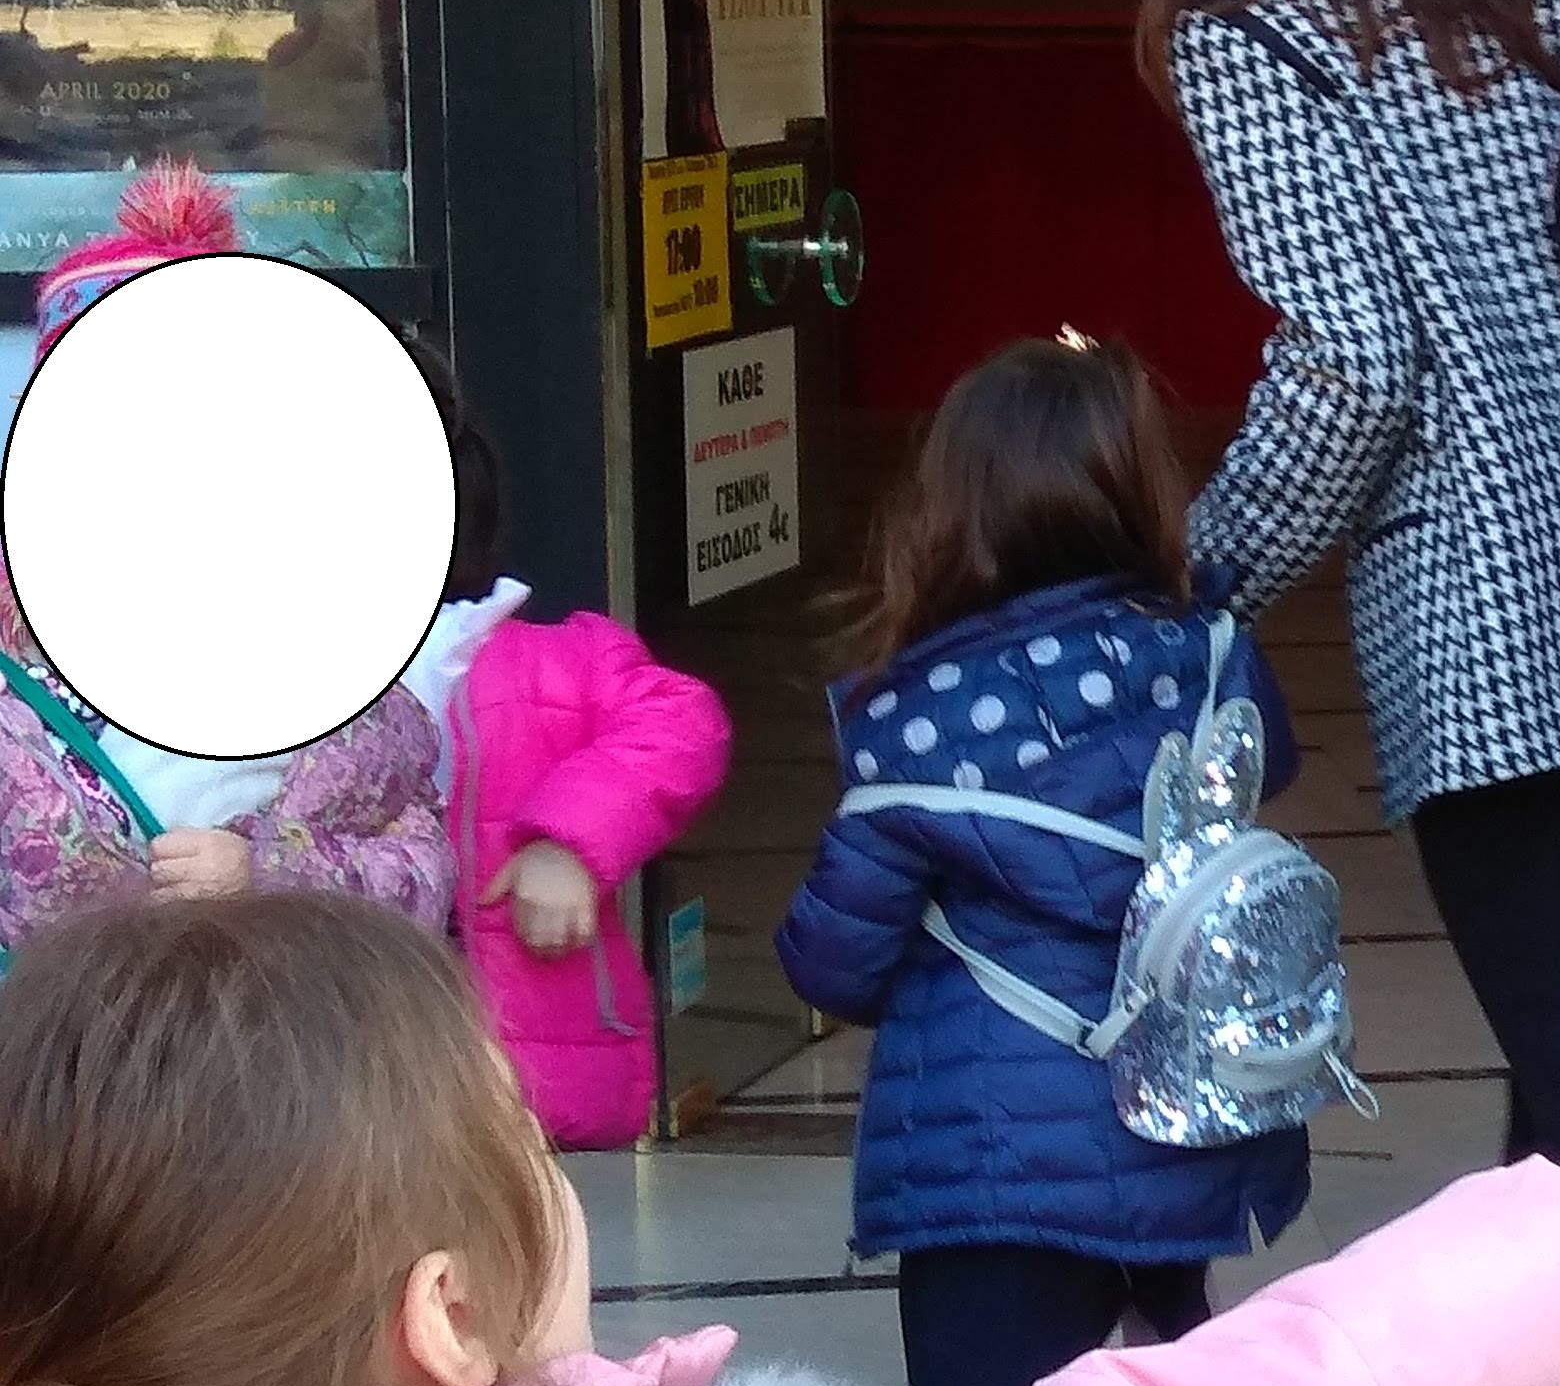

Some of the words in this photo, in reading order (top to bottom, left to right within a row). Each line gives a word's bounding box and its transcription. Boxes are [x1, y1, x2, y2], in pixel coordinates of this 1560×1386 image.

[39, 80, 100, 101] APRIL
[112, 80, 171, 101] 2020
[718, 362, 764, 406] ΚΑΘΕ
[715, 471, 770, 516] ΓΕΝΙΚΗ
[697, 521, 762, 573] ΕΙΣΟΔΟΣ
